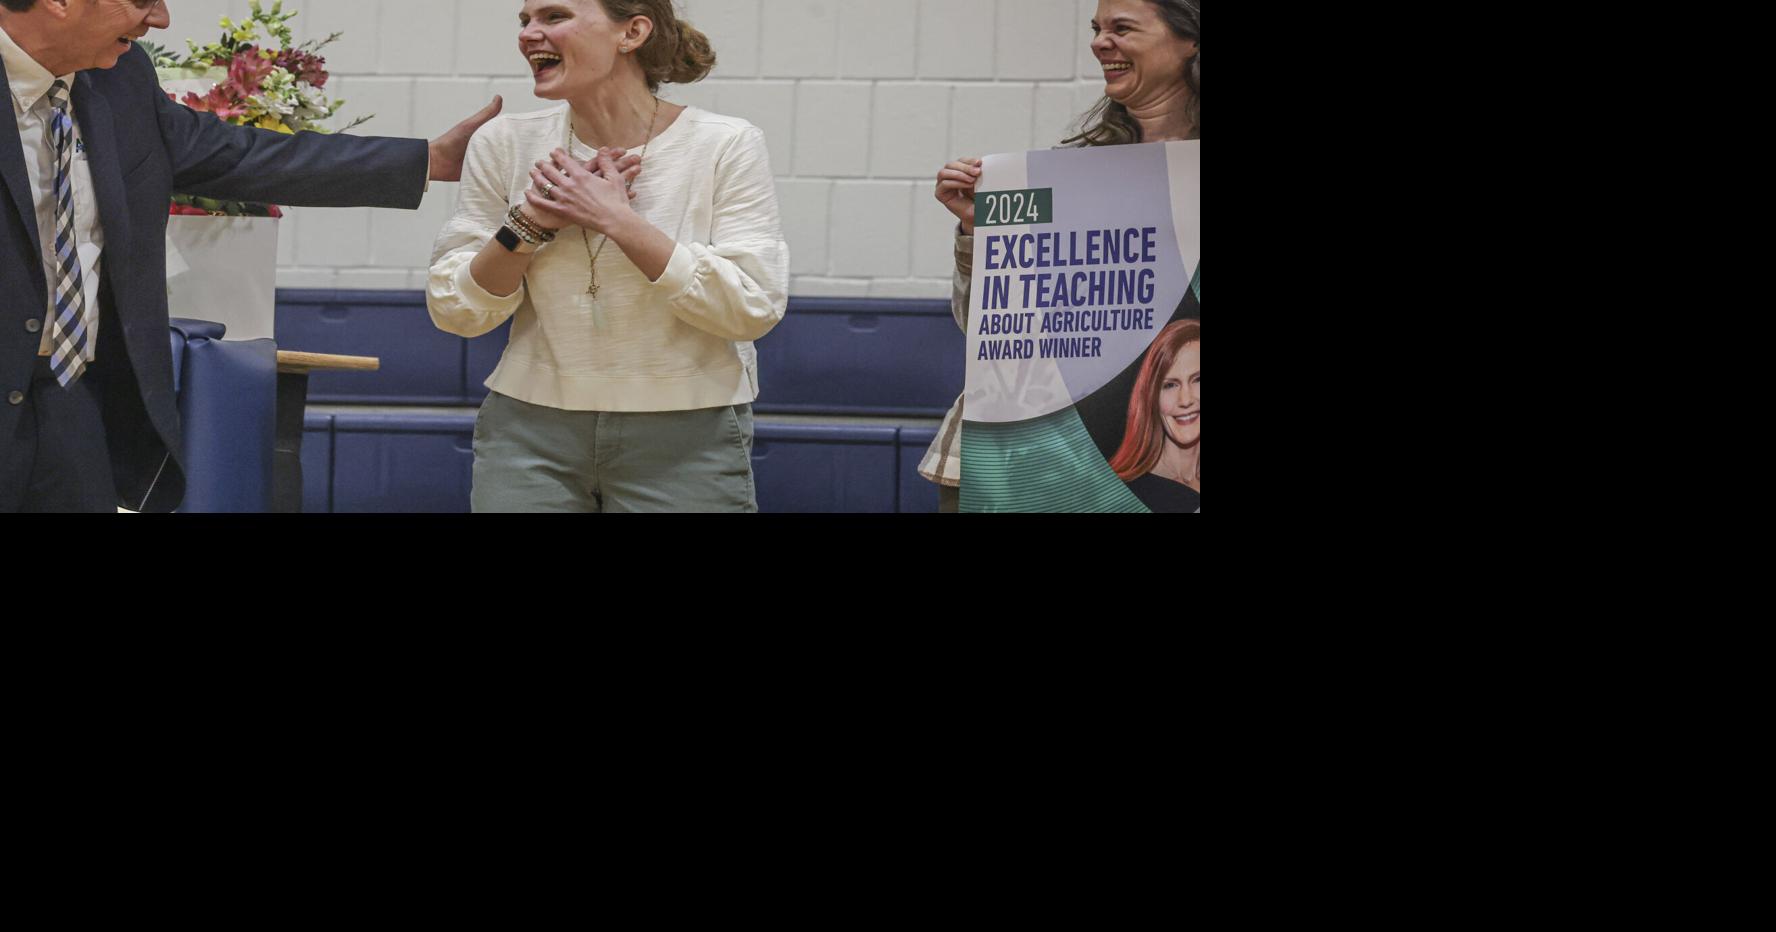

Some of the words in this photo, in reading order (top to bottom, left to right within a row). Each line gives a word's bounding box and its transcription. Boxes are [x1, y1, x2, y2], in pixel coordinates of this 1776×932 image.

[985, 192, 1039, 224] 2024
[985, 227, 1156, 270] EXCELLENCE
[982, 275, 1010, 310] IN
[1020, 269, 1155, 309] TEACHING
[979, 312, 1035, 335] ABOUT
[1040, 309, 1154, 334] AGRICULTURE
[977, 338, 1034, 361] AWARD
[1038, 337, 1102, 359] WINNER
